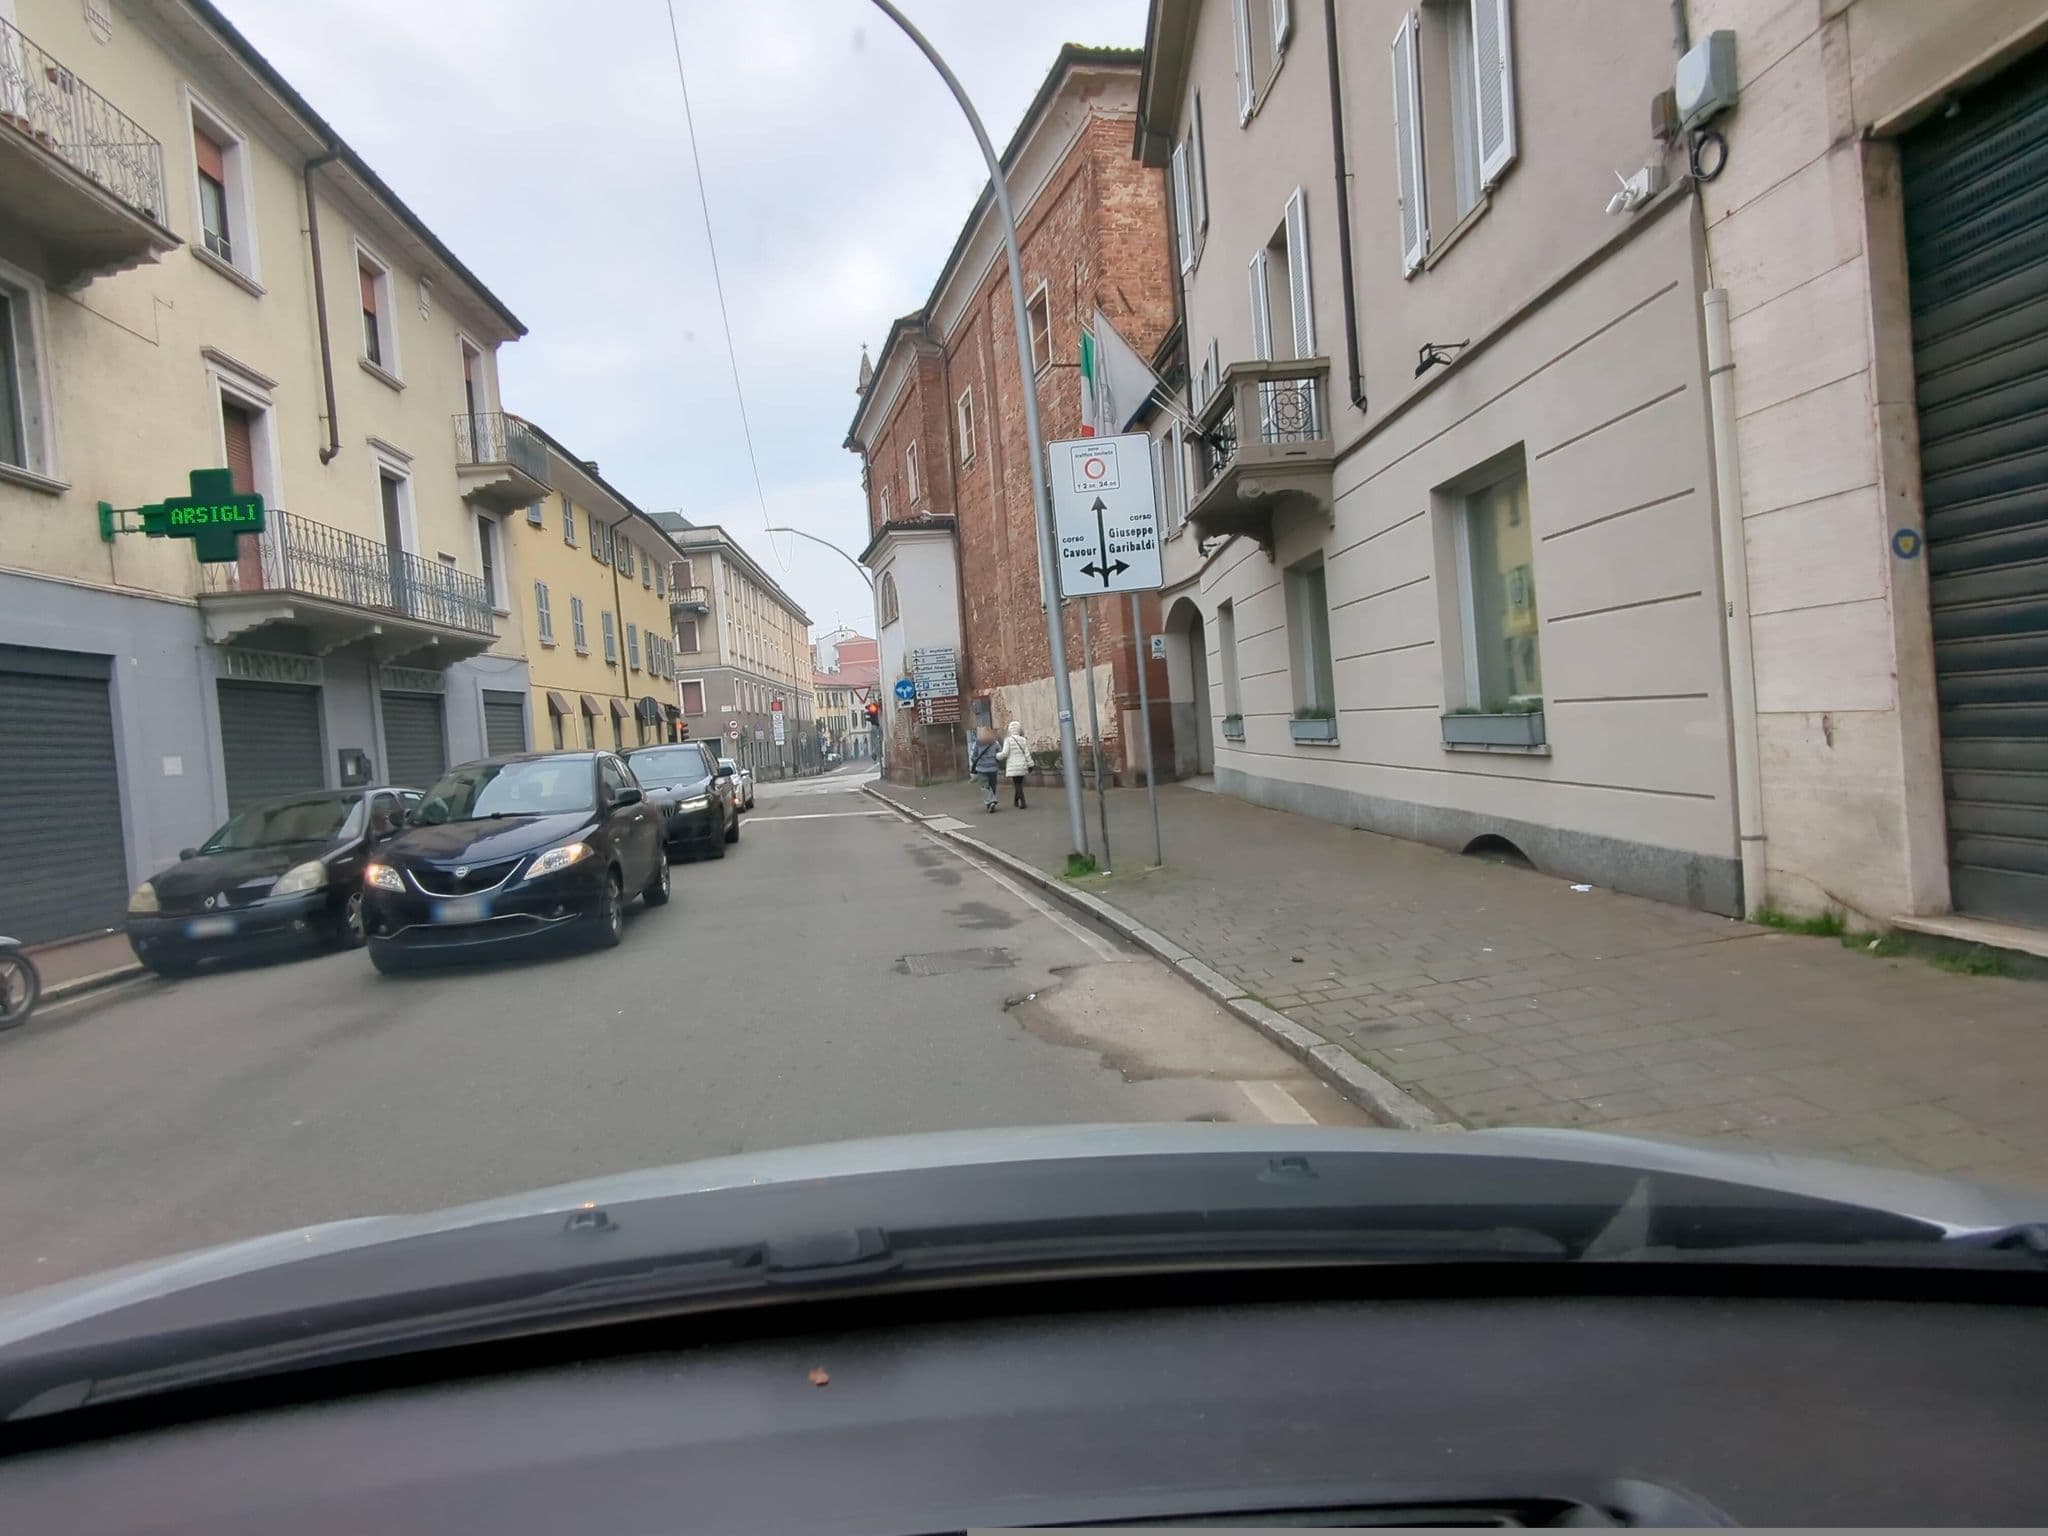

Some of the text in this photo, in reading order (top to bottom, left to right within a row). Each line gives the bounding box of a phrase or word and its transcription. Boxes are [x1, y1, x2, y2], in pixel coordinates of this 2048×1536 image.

[171, 504, 256, 525] ARSIGLI
[1130, 513, 1152, 521] corso
[1109, 526, 1153, 538] Giuseppe
[1063, 547, 1097, 558] Cavour
[1109, 540, 1155, 553] Garibaldi
